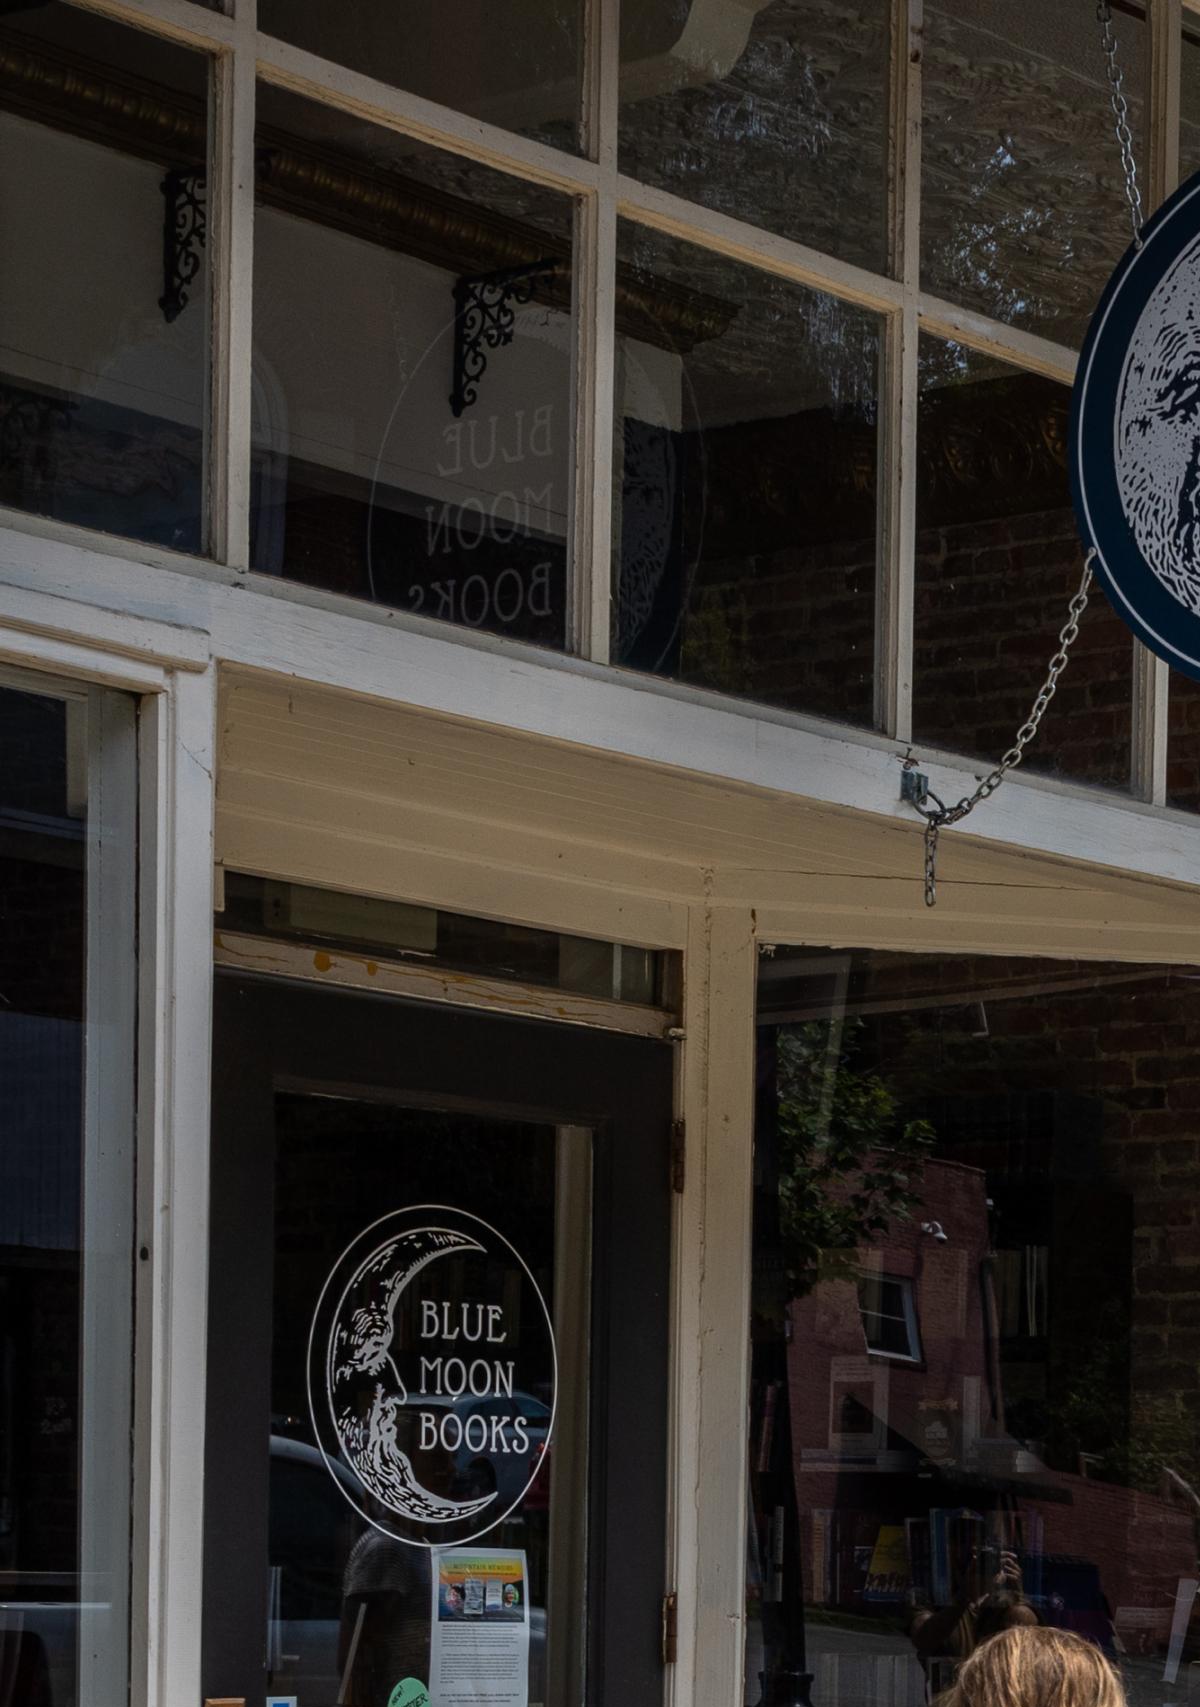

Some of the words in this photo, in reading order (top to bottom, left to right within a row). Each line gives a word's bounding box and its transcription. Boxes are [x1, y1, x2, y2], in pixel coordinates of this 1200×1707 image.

[421, 1300, 507, 1344] BLUE
[420, 1356, 515, 1399] MOON
[419, 1412, 529, 1454] BOOKS
